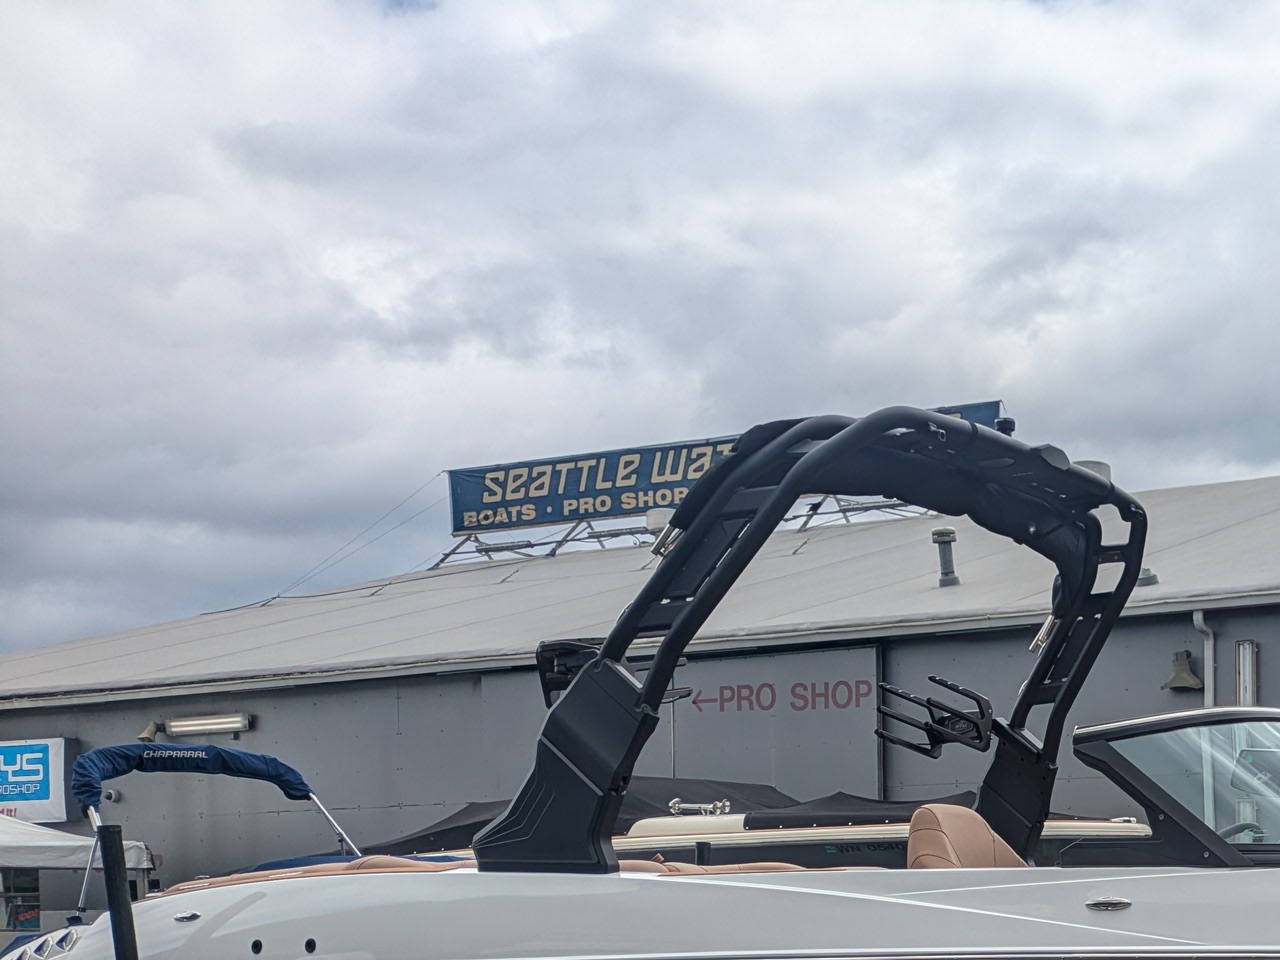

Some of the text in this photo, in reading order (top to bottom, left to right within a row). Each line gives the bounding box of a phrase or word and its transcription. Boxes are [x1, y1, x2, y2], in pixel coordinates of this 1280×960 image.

[463, 486, 689, 528] BOATS PRO SHOP
[719, 679, 873, 712] PRO SHOP
[143, 750, 209, 759] CHAPARRAL
